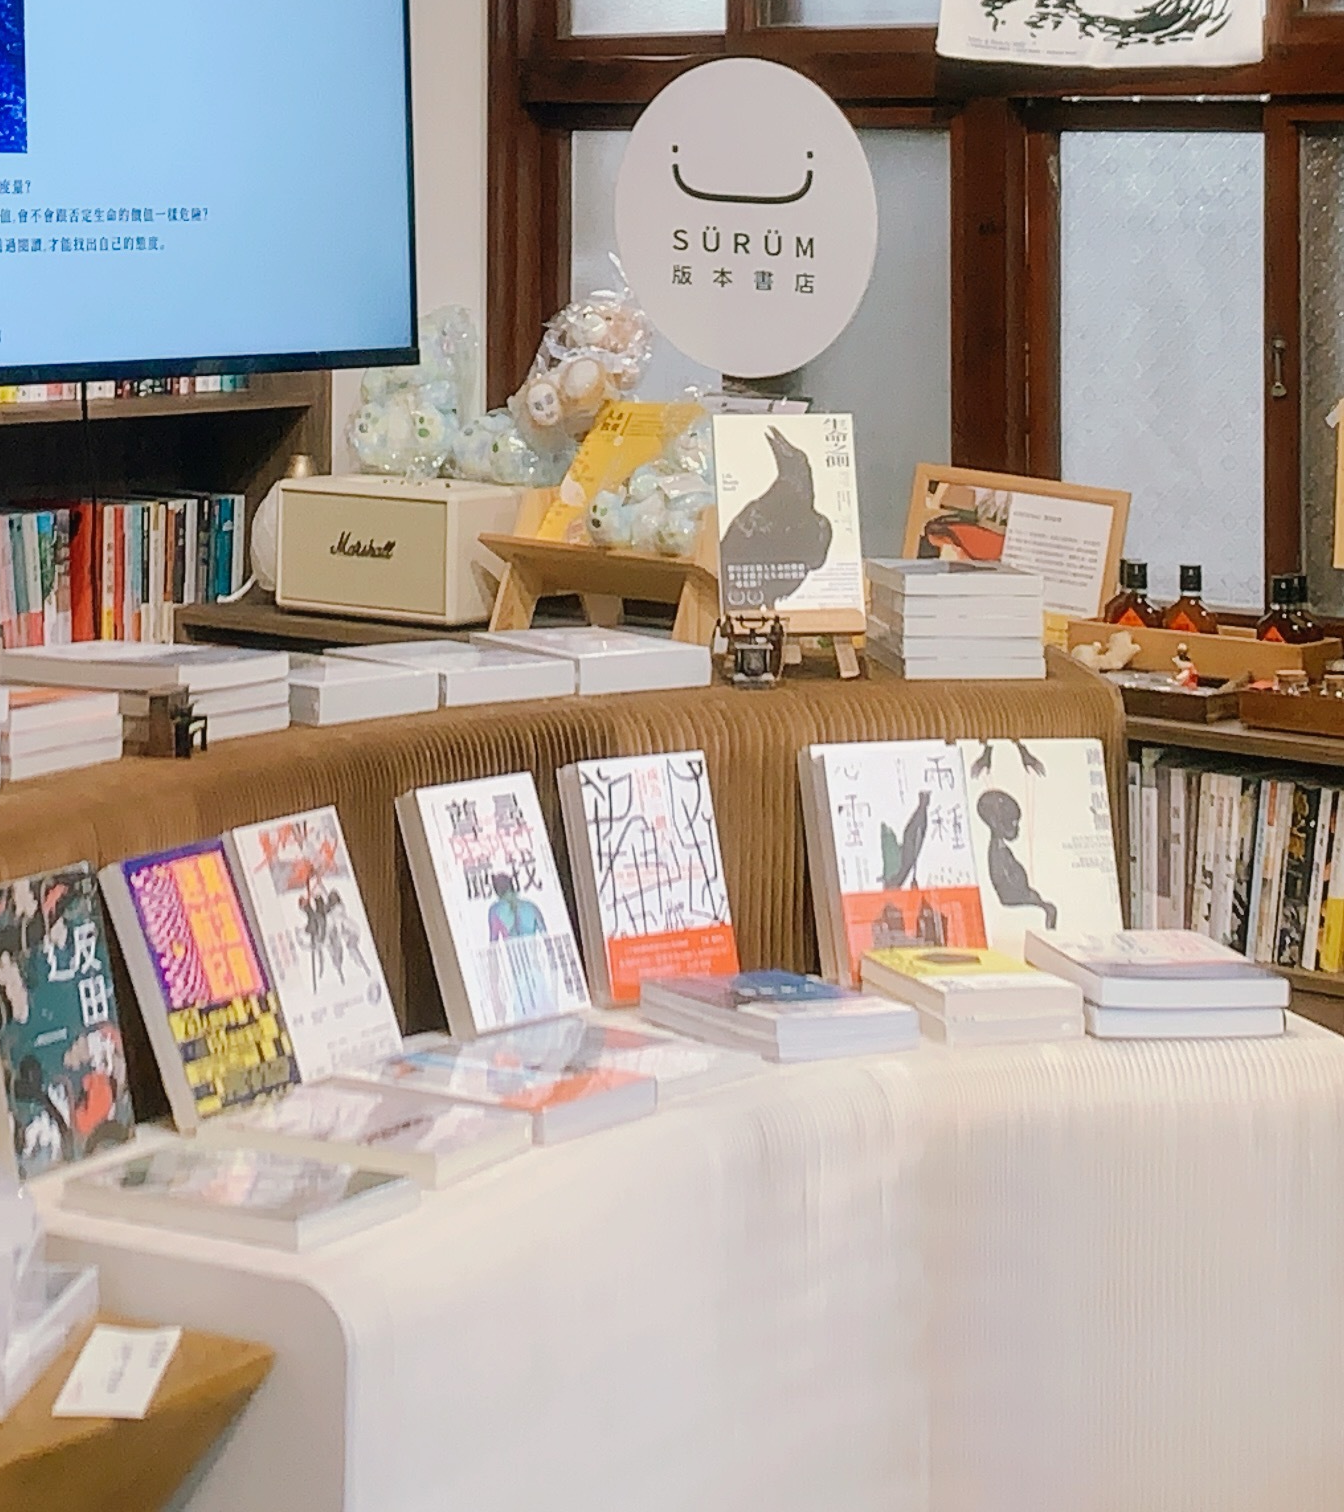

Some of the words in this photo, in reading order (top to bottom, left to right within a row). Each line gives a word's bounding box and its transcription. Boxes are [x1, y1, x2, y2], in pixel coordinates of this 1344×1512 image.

[672, 224, 815, 259] SÜRÜM
[671, 264, 816, 295] 版本書店
[329, 530, 397, 560] Marshall
